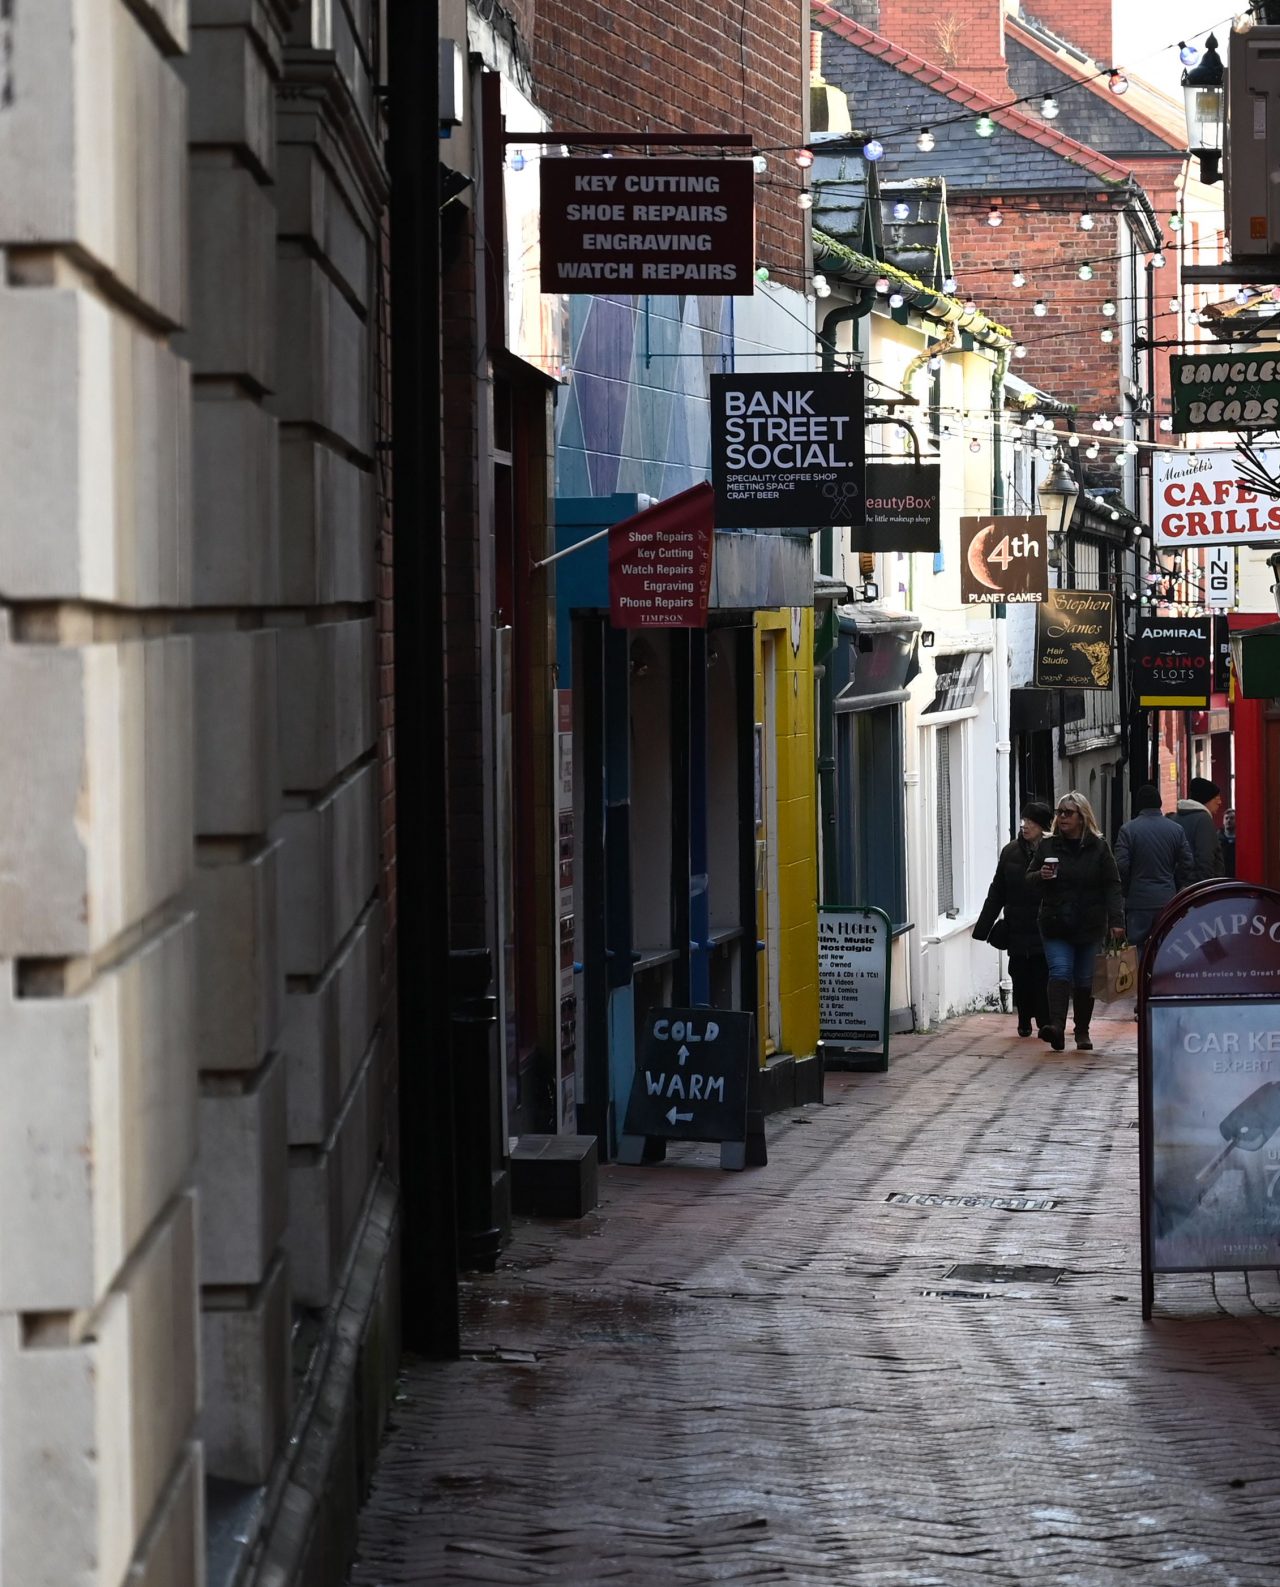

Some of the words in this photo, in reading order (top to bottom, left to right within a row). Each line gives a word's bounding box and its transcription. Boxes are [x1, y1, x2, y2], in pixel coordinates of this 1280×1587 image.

[575, 175, 617, 193] KEY
[624, 175, 720, 193] CUTTING
[566, 204, 625, 221] SHOE
[633, 204, 728, 222] REPAIRS
[582, 233, 712, 251] ENGRAVING
[557, 262, 634, 280] WATCH
[642, 262, 737, 280] REPAIRS
[724, 390, 816, 416] BANK
[1188, 398, 1280, 424] BEADS
[724, 416, 850, 443] STREET
[724, 443, 854, 470] SOCIAL.
[726, 473, 777, 483] SPECIALITY
[778, 473, 812, 481] COFFEE
[812, 472, 838, 481] SHOP
[726, 483, 765, 491] MEETING
[766, 482, 796, 490] SPACE
[1163, 478, 1259, 508] CAFE
[726, 491, 756, 500] CRAFT
[757, 491, 780, 499] BEER
[866, 495, 932, 512] eautyBox
[865, 514, 874, 523] he
[874, 514, 888, 523] little
[889, 514, 915, 525] makeup
[915, 514, 932, 525] shop
[628, 531, 654, 542] Shoe
[656, 531, 694, 543] Repairs
[637, 548, 656, 558] Key
[658, 548, 694, 560] Cutting
[986, 533, 1039, 571] 4th
[621, 564, 654, 575] Watch
[656, 564, 694, 576] Repairs
[1211, 547, 1228, 591] ING
[643, 580, 694, 593] Engraving
[620, 596, 652, 608] Phone
[655, 596, 694, 609] Repairs
[968, 593, 1006, 603] PLANET
[1007, 592, 1042, 602] GAMES
[1052, 594, 1110, 615] Stephen
[640, 614, 683, 622] TIMPSON
[1047, 618, 1103, 638] James
[1141, 627, 1207, 640] ADMIRAL
[1046, 647, 1065, 655] Hair
[1041, 656, 1069, 665] Studio
[1141, 655, 1206, 668] CASINO
[1152, 669, 1195, 680] SLOTS
[820, 944, 872, 952] Nostalgia
[1174, 971, 1200, 979] Great
[1201, 970, 1234, 978] Service
[1236, 970, 1247, 979] by
[1250, 969, 1274, 977] Great
[653, 1019, 720, 1043] COLD
[1183, 1031, 1240, 1054] CAR
[1212, 1060, 1273, 1074] EXPERT
[645, 1070, 725, 1103] WARM
